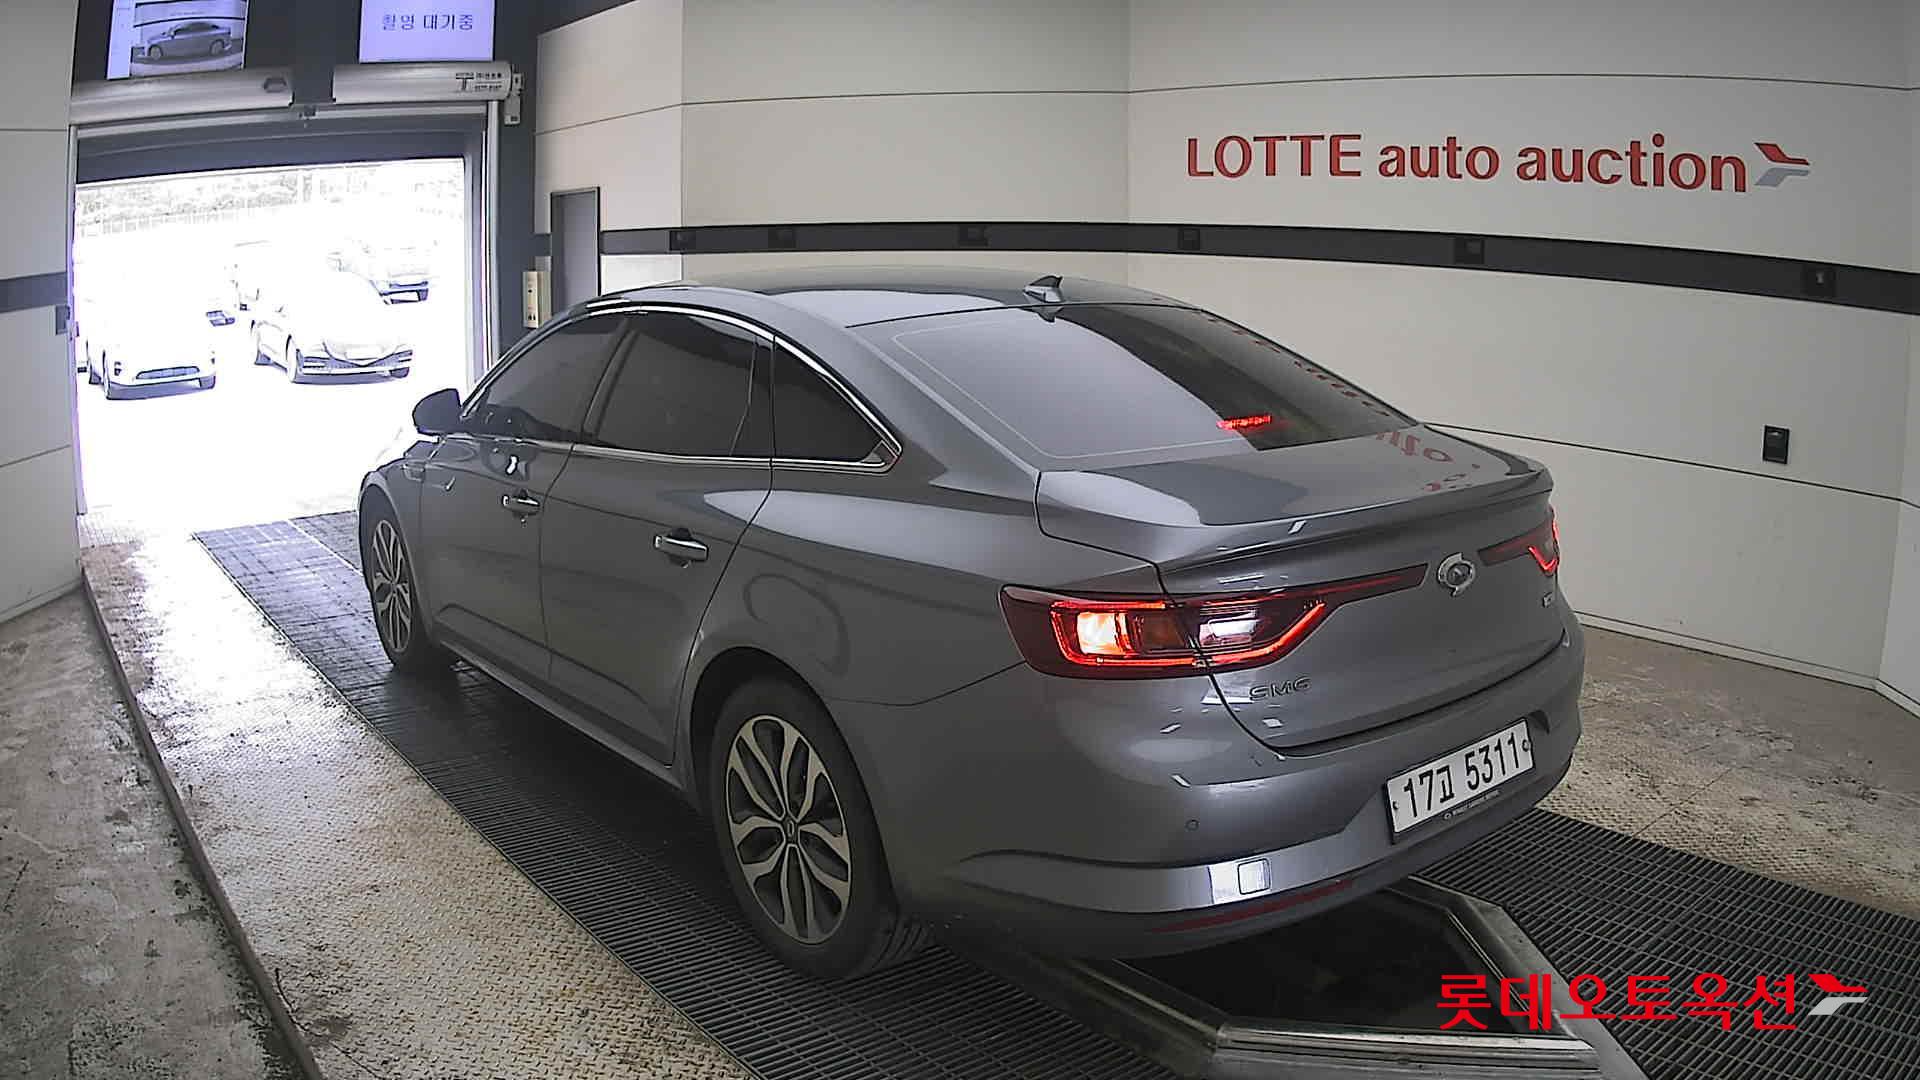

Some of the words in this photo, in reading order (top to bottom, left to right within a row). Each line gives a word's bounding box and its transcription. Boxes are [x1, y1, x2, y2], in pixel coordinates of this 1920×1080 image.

[423, 13, 473, 31] 대기중
[1187, 134, 1362, 178] LOTTE
[1379, 137, 1501, 181] auto
[1517, 134, 1747, 193] auction
[1403, 765, 1455, 818] 17고
[1464, 731, 1519, 791] 5311
